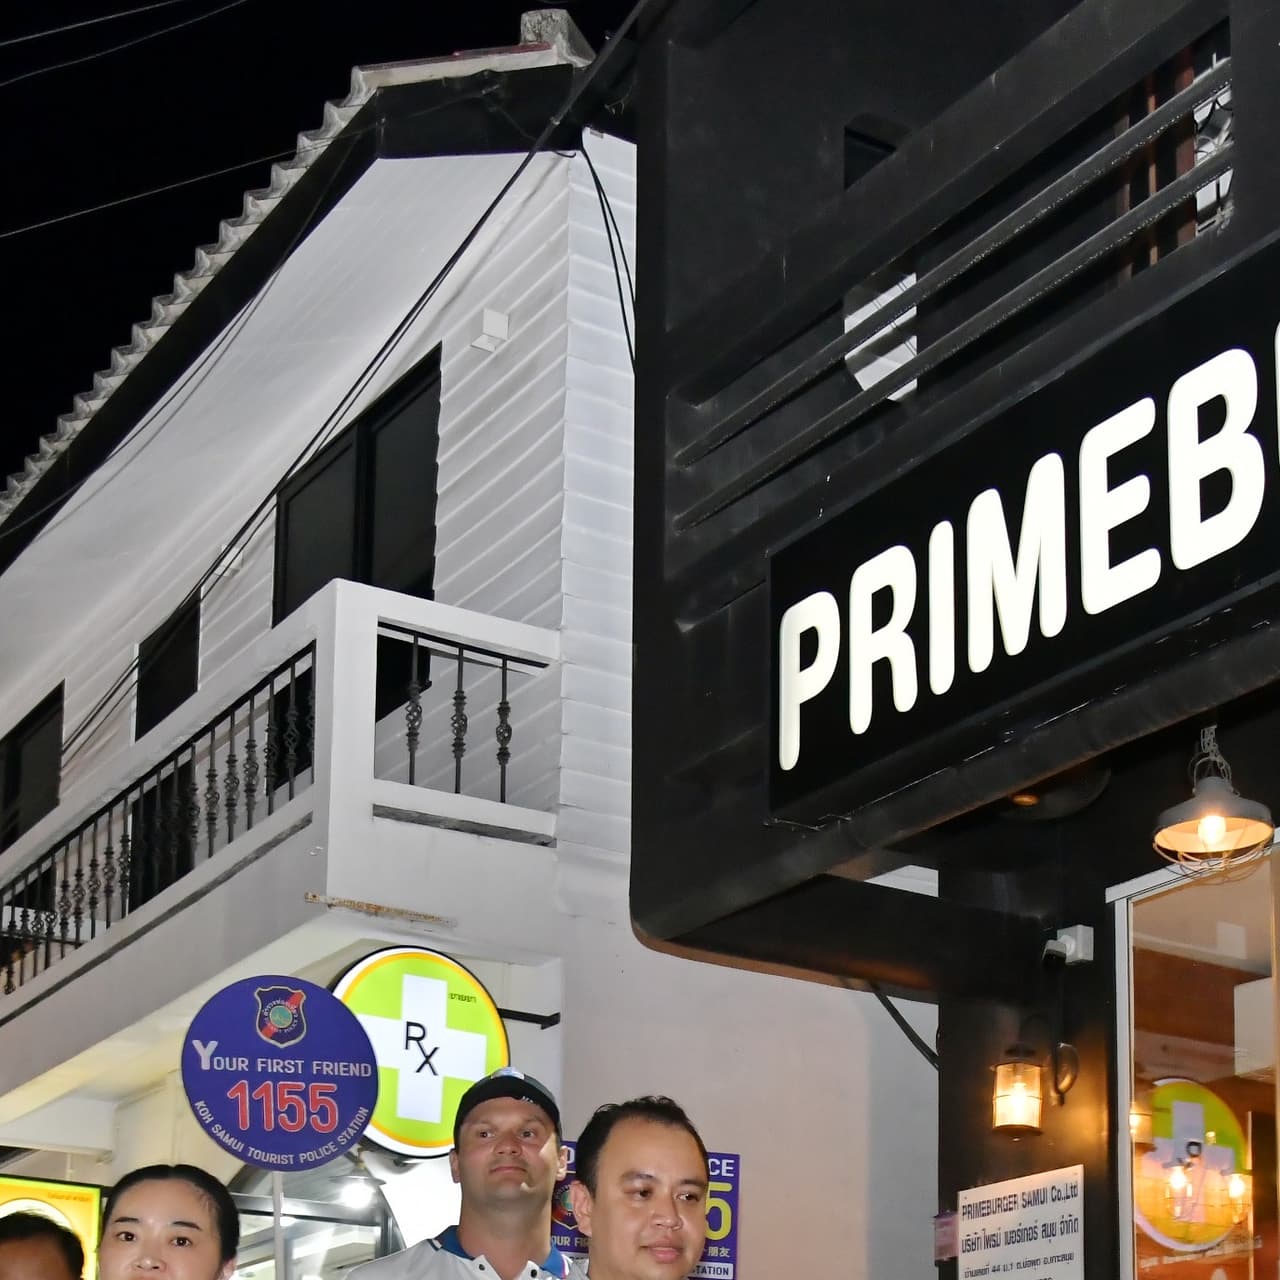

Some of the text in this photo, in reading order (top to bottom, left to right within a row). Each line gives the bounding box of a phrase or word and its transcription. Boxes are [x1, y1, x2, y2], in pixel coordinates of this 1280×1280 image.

[257, 1059, 304, 1074] FIRST
[312, 1061, 371, 1077] FRIEND
[227, 1080, 339, 1133] 1155
[195, 1100, 369, 1165] KOH SAMUI TOURIST POLICE STATION
[962, 1194, 1019, 1220] PRIMEBURGER
[1022, 1188, 1048, 1208] SAMUI
[1041, 1222, 1056, 1243] สมุย
[1060, 1214, 1079, 1236] จำกัด
[991, 1264, 1000, 1273] 44
